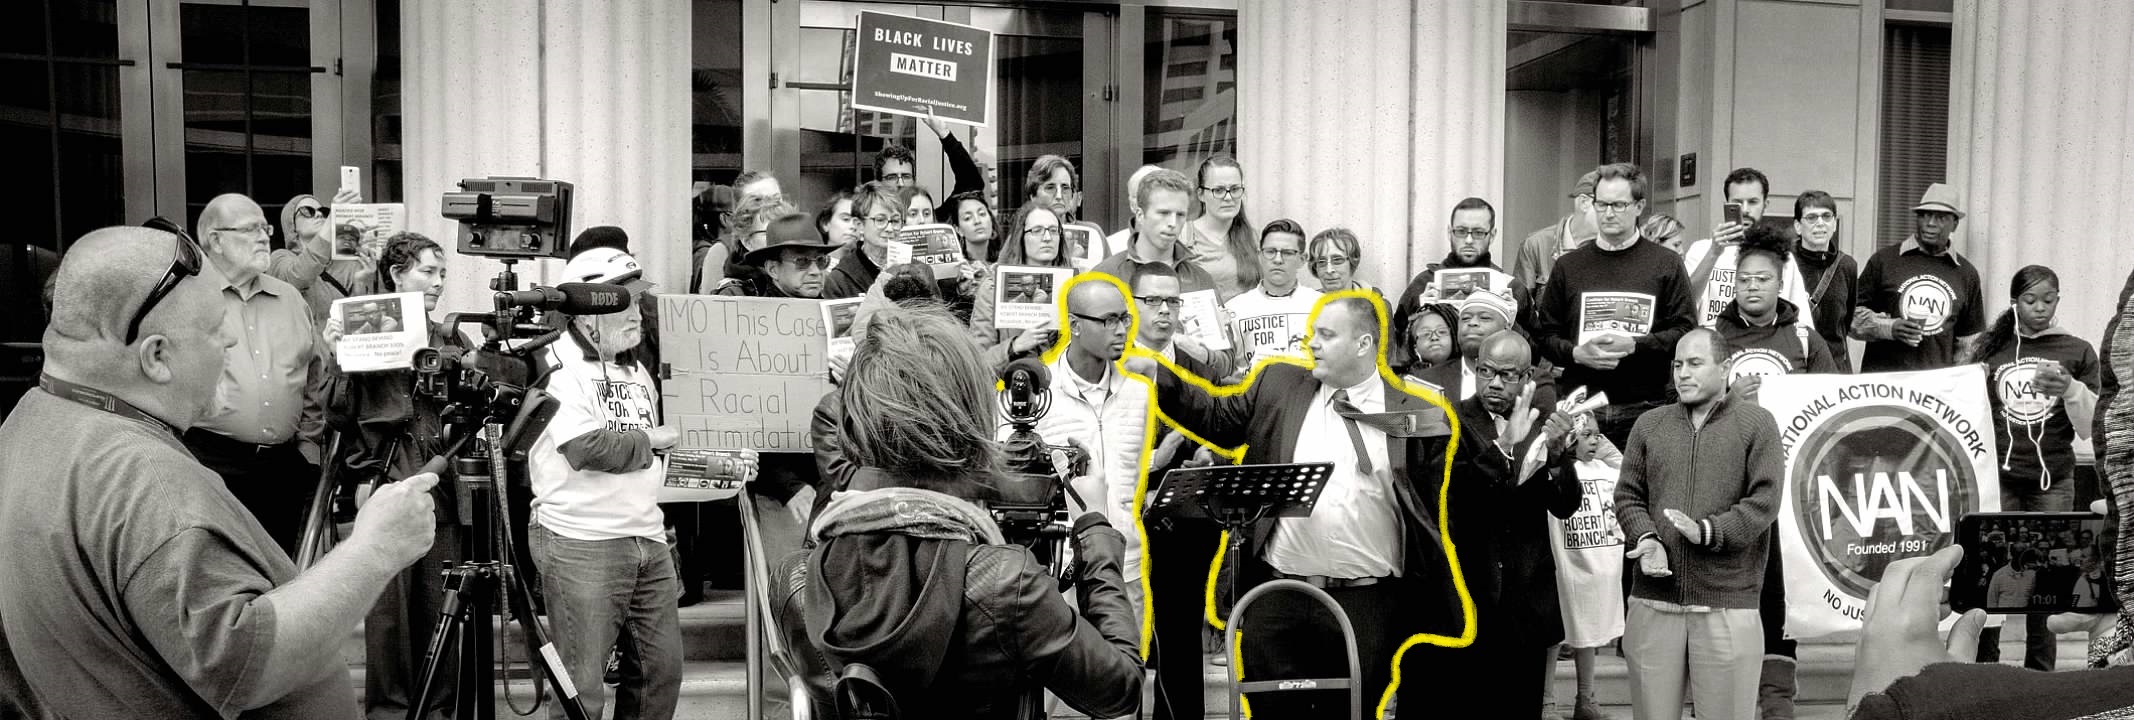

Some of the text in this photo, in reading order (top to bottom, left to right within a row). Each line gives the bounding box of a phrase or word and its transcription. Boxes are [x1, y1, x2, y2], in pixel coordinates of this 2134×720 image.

[875, 28, 973, 56] BLACK LIVES
[896, 56, 952, 77] MATTER
[1711, 270, 1737, 283] JUST
[663, 297, 828, 337] IMO This Case
[1243, 315, 1285, 333] JUSTICE
[1254, 331, 1275, 346] FOR
[698, 338, 812, 373] Is About
[700, 378, 788, 415] Racial
[1782, 383, 1988, 460] ATIONAL ACTION NETWORK
[1817, 468, 1951, 540] NAN
[1566, 531, 1606, 547] BRANCH
[1846, 540, 1928, 555] Founded 1991
[1823, 588, 1842, 610] NO
